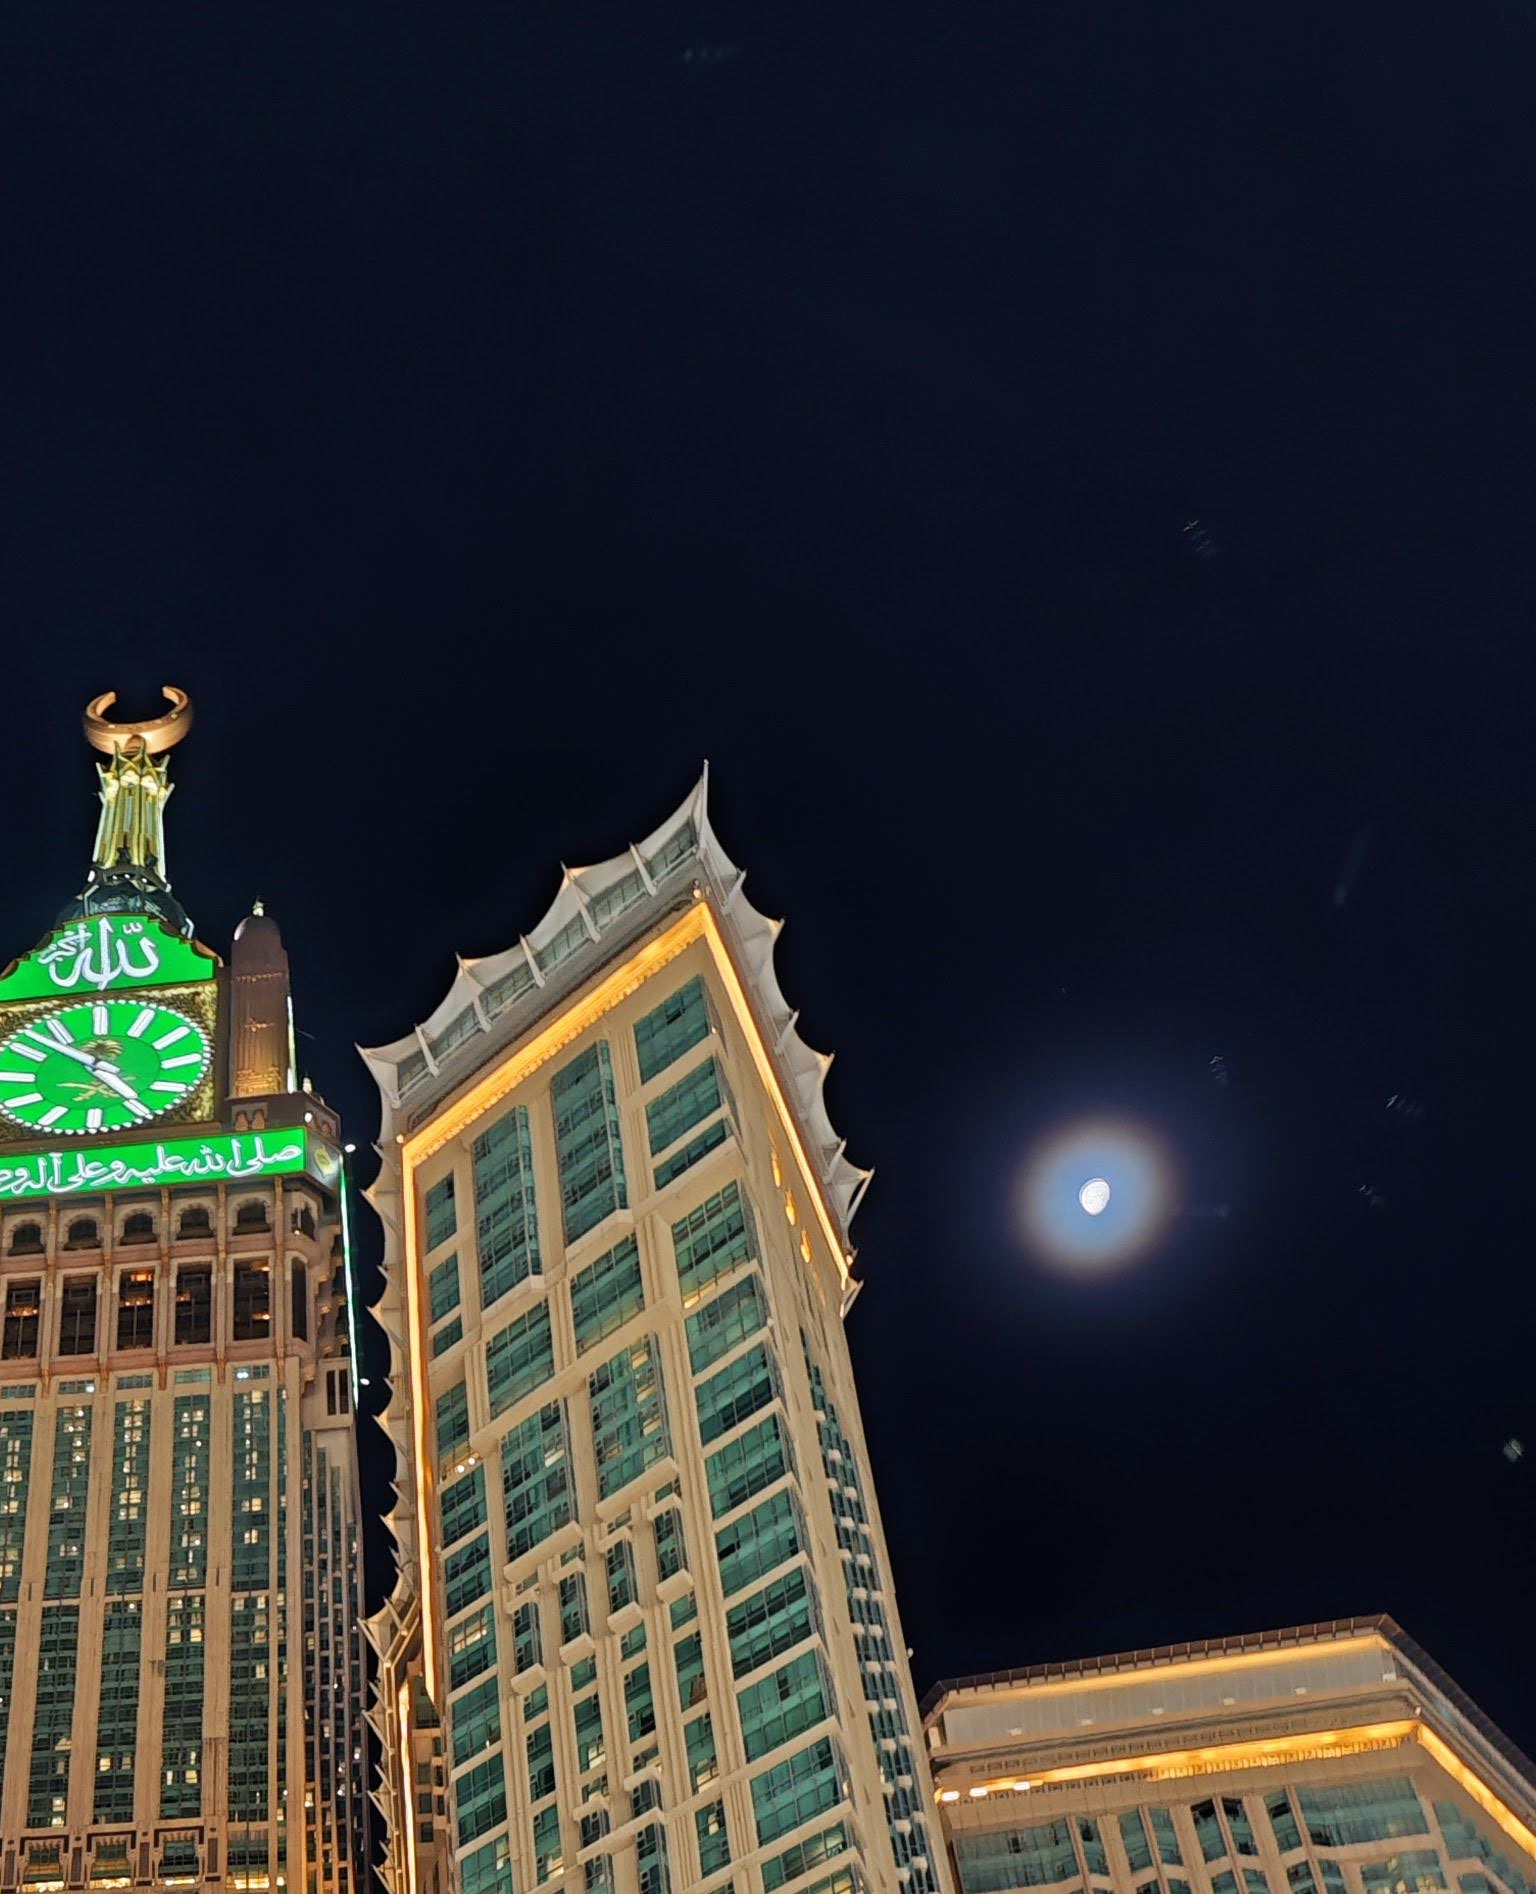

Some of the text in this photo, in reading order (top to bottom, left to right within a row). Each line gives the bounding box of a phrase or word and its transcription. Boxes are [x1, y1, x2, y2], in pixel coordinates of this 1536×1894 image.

[48, 916, 160, 991] الله
[12, 1152, 64, 1194] آله
[47, 1153, 126, 1193] وعلى
[115, 1145, 186, 1184] عليه
[180, 1138, 242, 1176] الله
[226, 1136, 302, 1177] صلى
